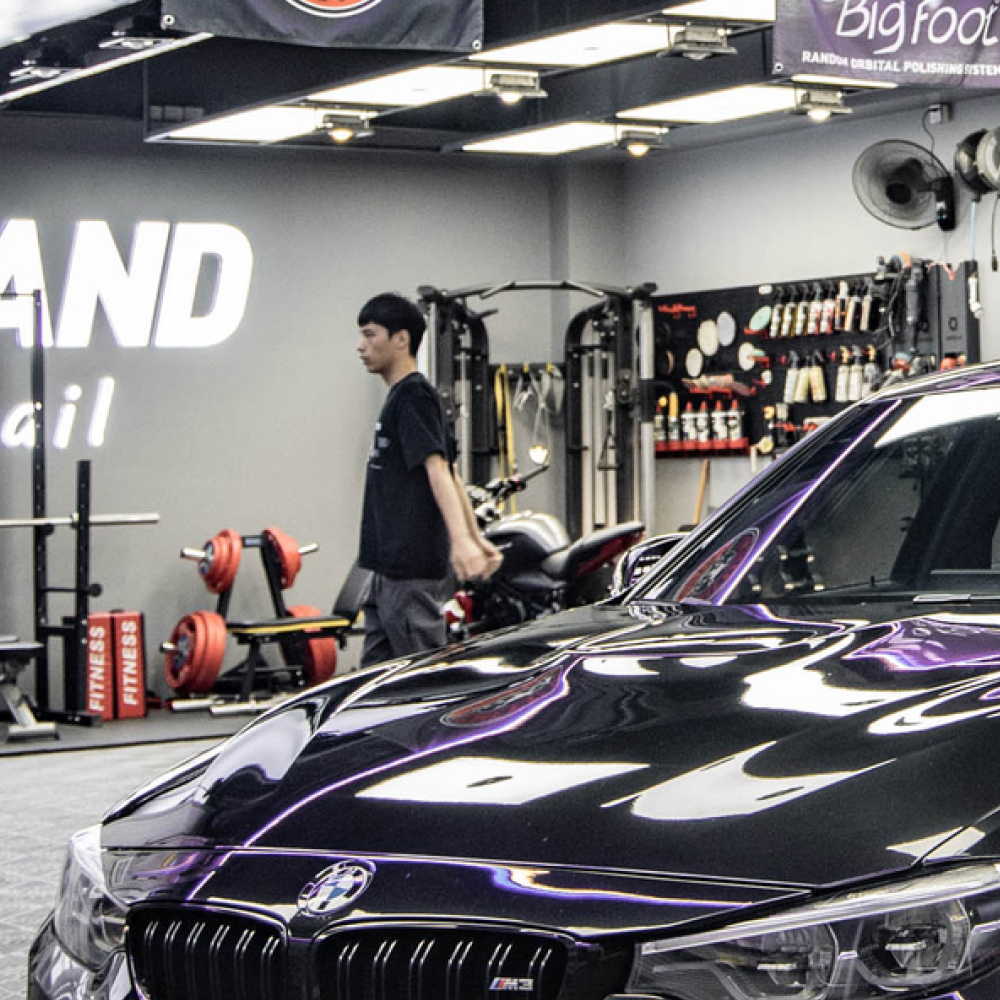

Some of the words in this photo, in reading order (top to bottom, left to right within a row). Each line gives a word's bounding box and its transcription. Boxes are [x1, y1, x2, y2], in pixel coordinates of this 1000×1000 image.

[850, 58, 900, 73] ORBITAL
[903, 61, 964, 76] POLISHING
[89, 626, 105, 712] FITNESS
[122, 621, 138, 706] FITNESS
